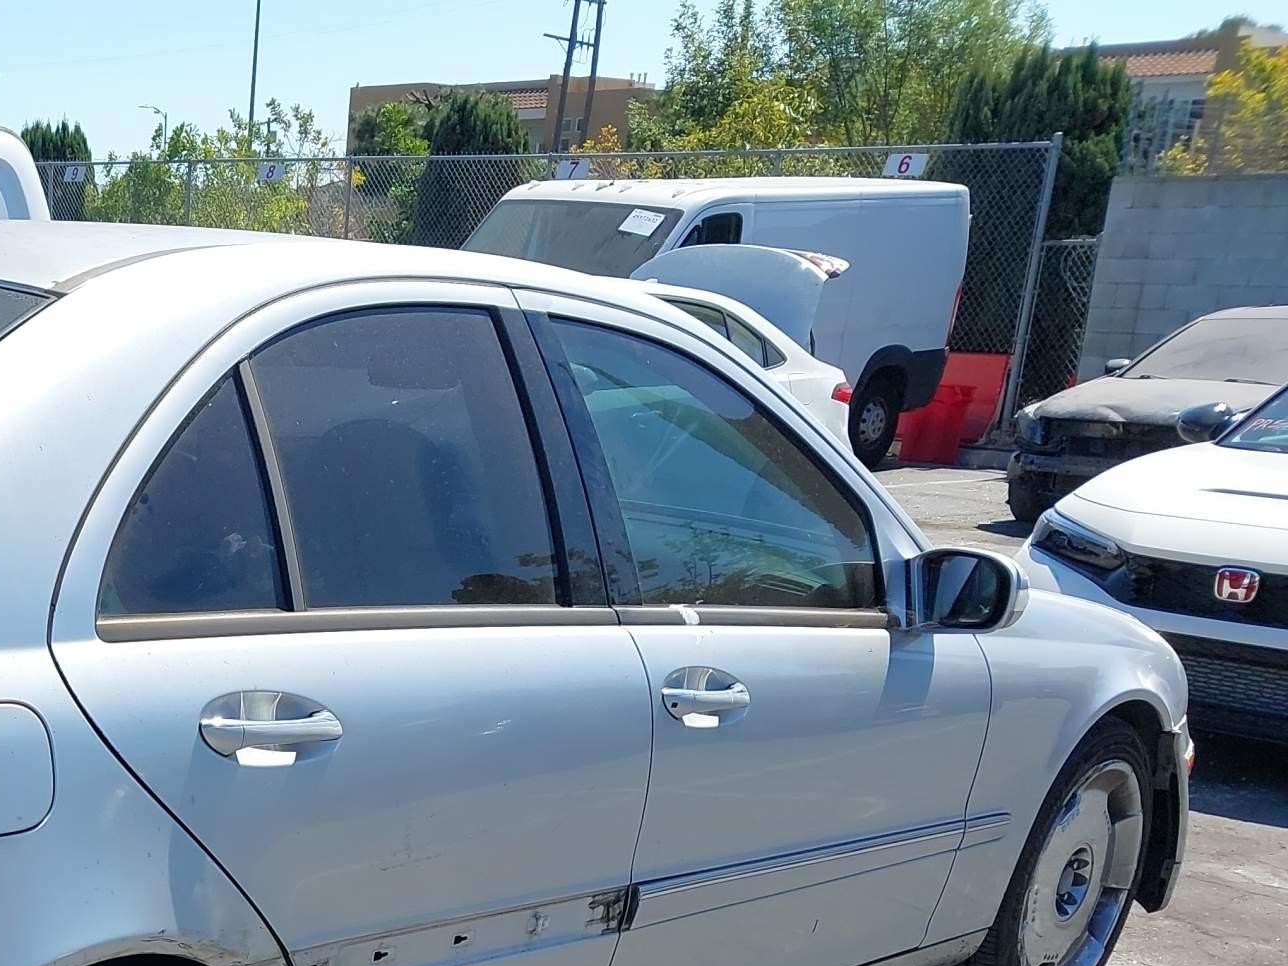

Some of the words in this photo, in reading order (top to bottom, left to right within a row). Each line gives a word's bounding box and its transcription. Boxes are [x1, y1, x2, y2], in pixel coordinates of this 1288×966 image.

[266, 165, 276, 179] 8
[568, 161, 580, 179] 7
[897, 155, 913, 174] 6
[71, 167, 79, 181] 9
